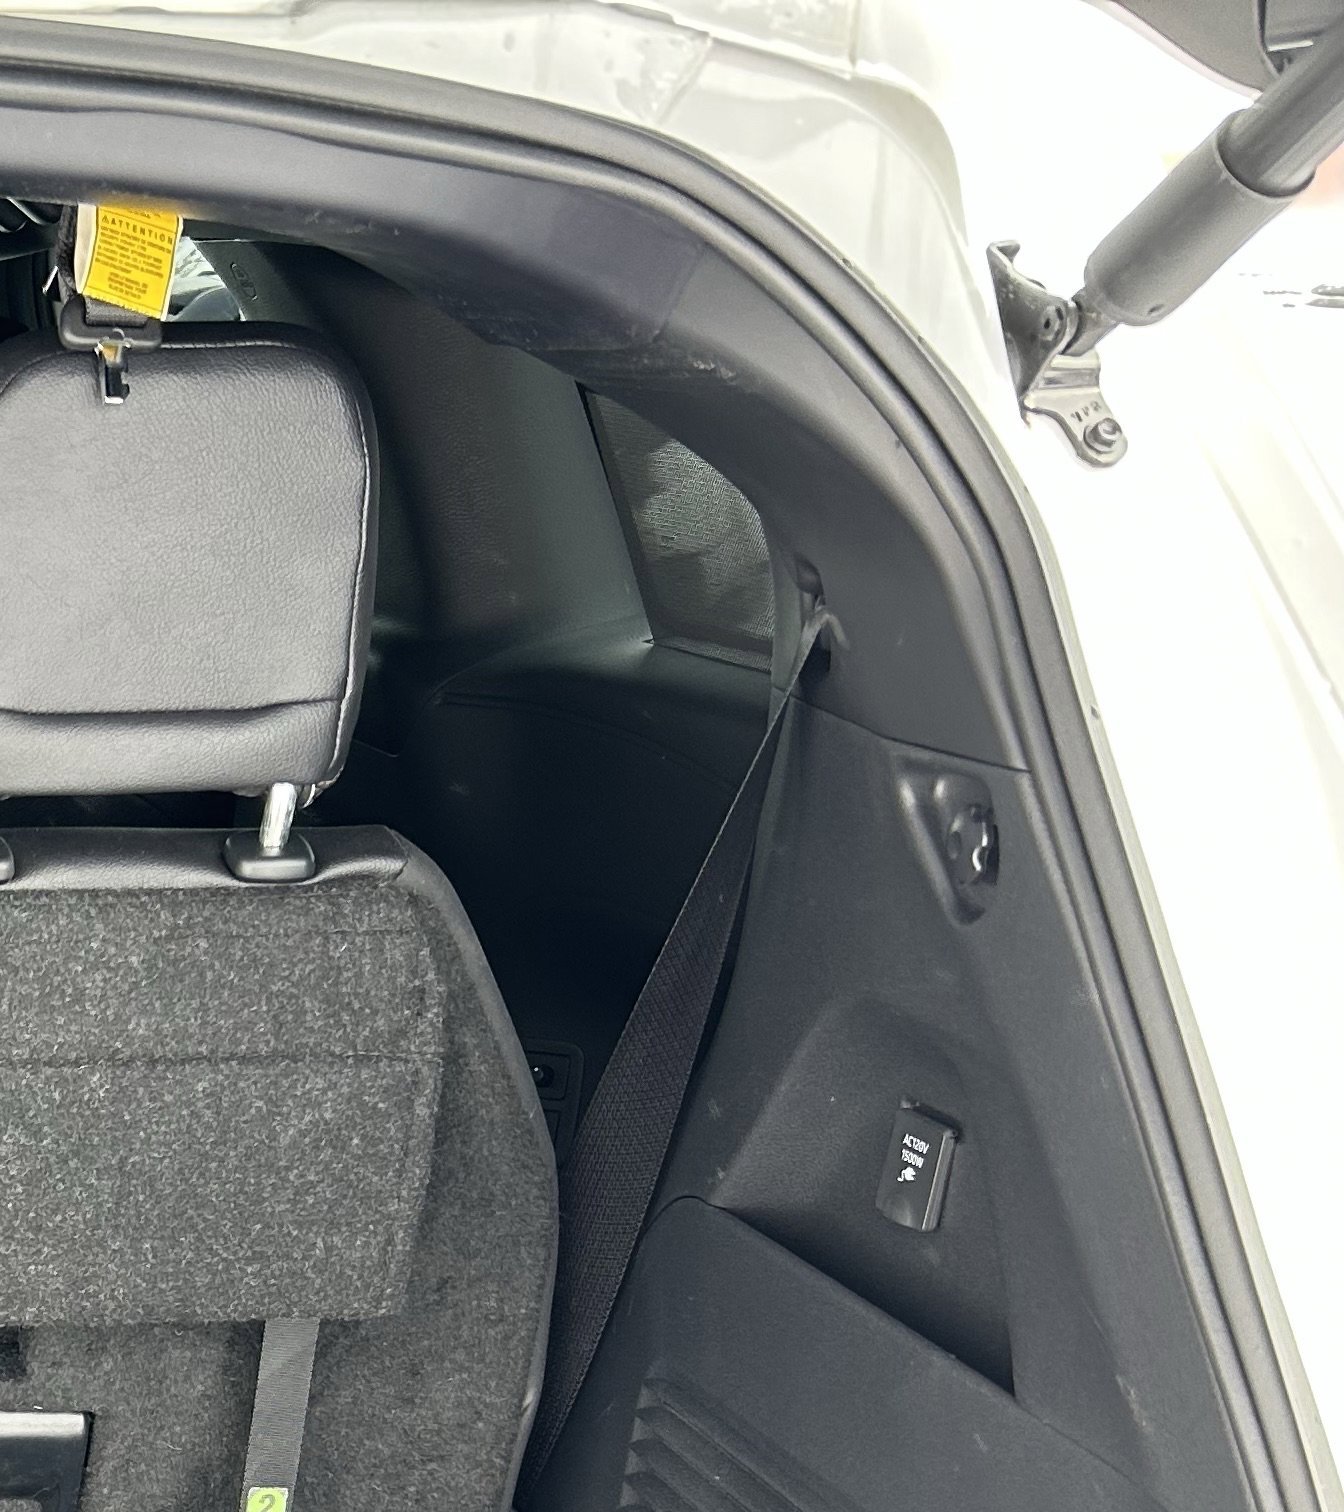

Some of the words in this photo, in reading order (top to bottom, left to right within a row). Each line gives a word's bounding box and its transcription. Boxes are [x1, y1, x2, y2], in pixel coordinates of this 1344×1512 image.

[111, 217, 173, 245] ATTENTION
[902, 1133, 930, 1155] AC120V
[901, 1148, 925, 1169] 1500W
